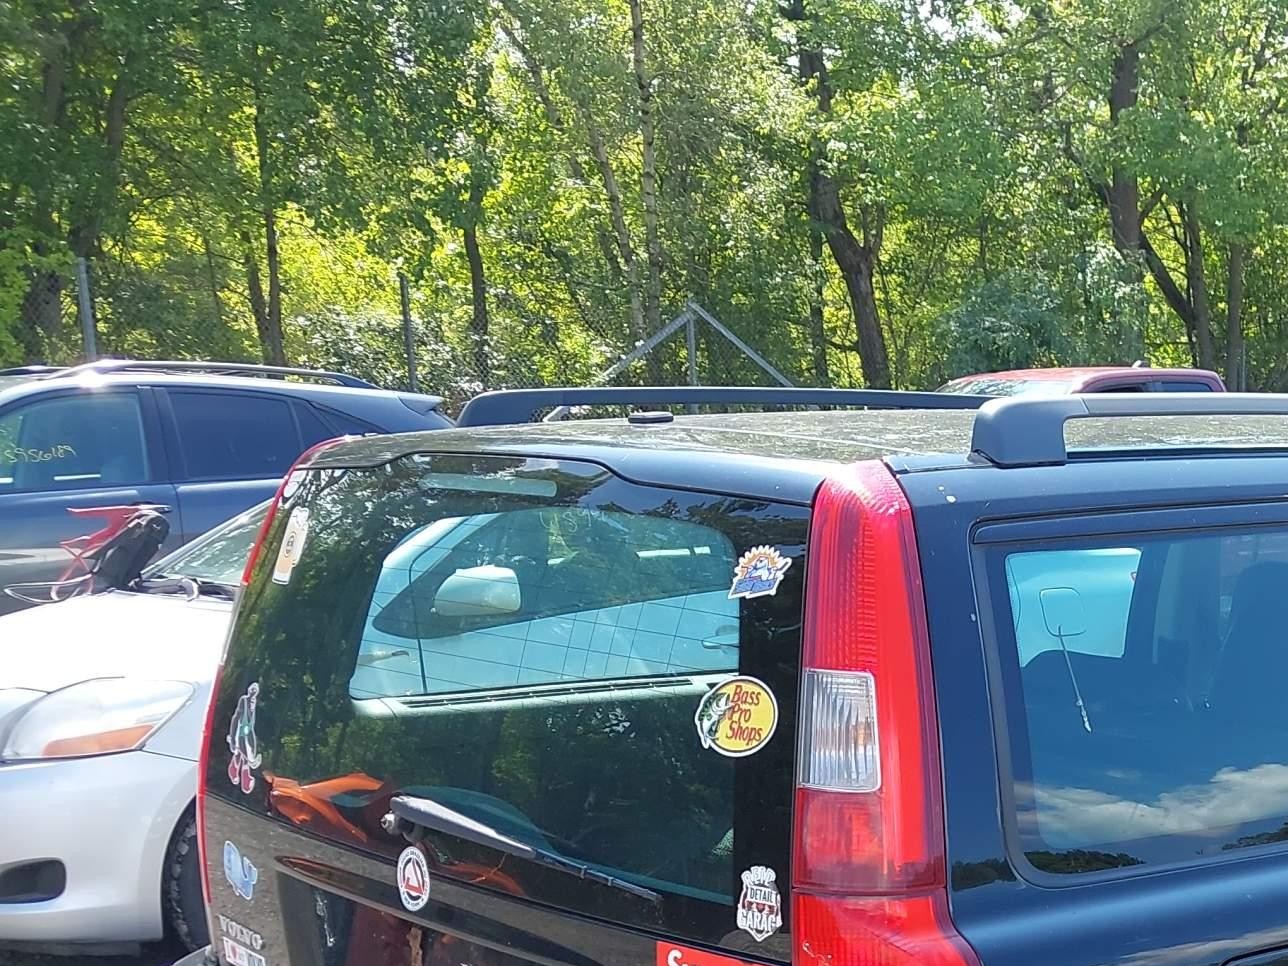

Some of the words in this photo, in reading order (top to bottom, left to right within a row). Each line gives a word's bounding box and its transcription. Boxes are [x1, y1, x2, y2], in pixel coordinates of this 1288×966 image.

[731, 684, 762, 706] Bass
[728, 703, 752, 723] Pro
[726, 720, 764, 746] Shops
[750, 887, 774, 903] DETAIL
[738, 908, 783, 932] GARAG
[219, 914, 263, 950] VOLVO
